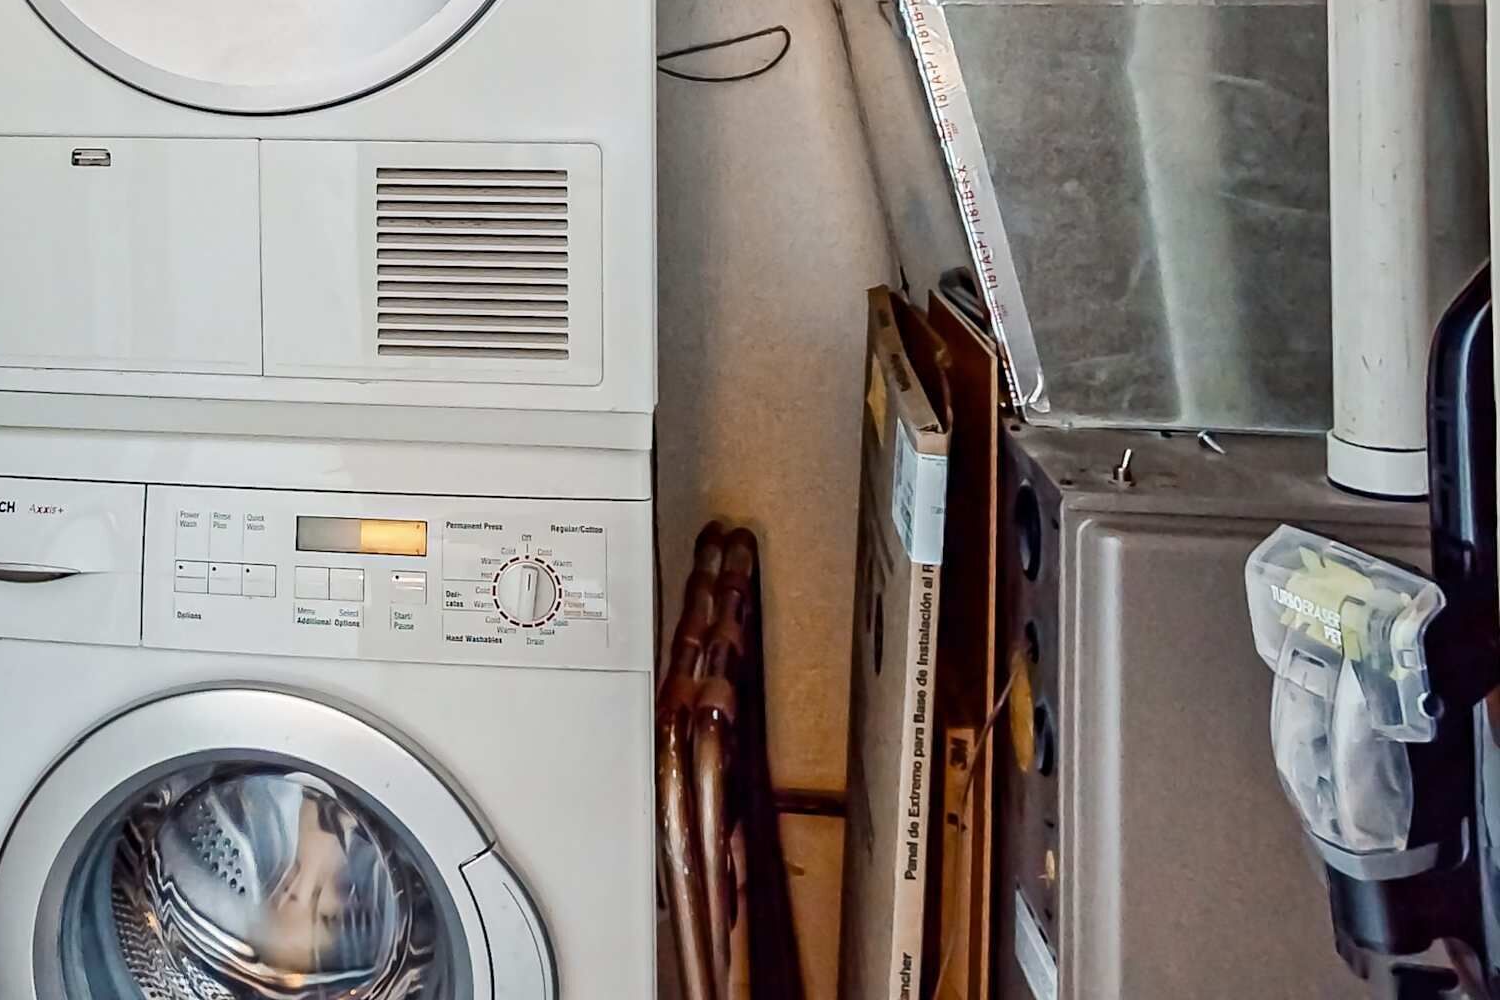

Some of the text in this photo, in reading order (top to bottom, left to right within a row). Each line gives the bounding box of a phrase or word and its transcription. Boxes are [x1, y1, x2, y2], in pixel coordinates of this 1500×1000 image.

[446, 521, 503, 530] Permanent Press
[551, 524, 603, 534] Regular/Cotton
[922, 577, 933, 589] al
[297, 617, 360, 628] Additional Options
[916, 592, 933, 665] Instalación
[466, 635, 502, 644] Washables
[915, 670, 928, 686] de
[913, 689, 927, 724] Base
[912, 727, 925, 758] para
[908, 760, 922, 818] Extremo
[907, 821, 920, 839] de
[904, 841, 918, 881] Panel
